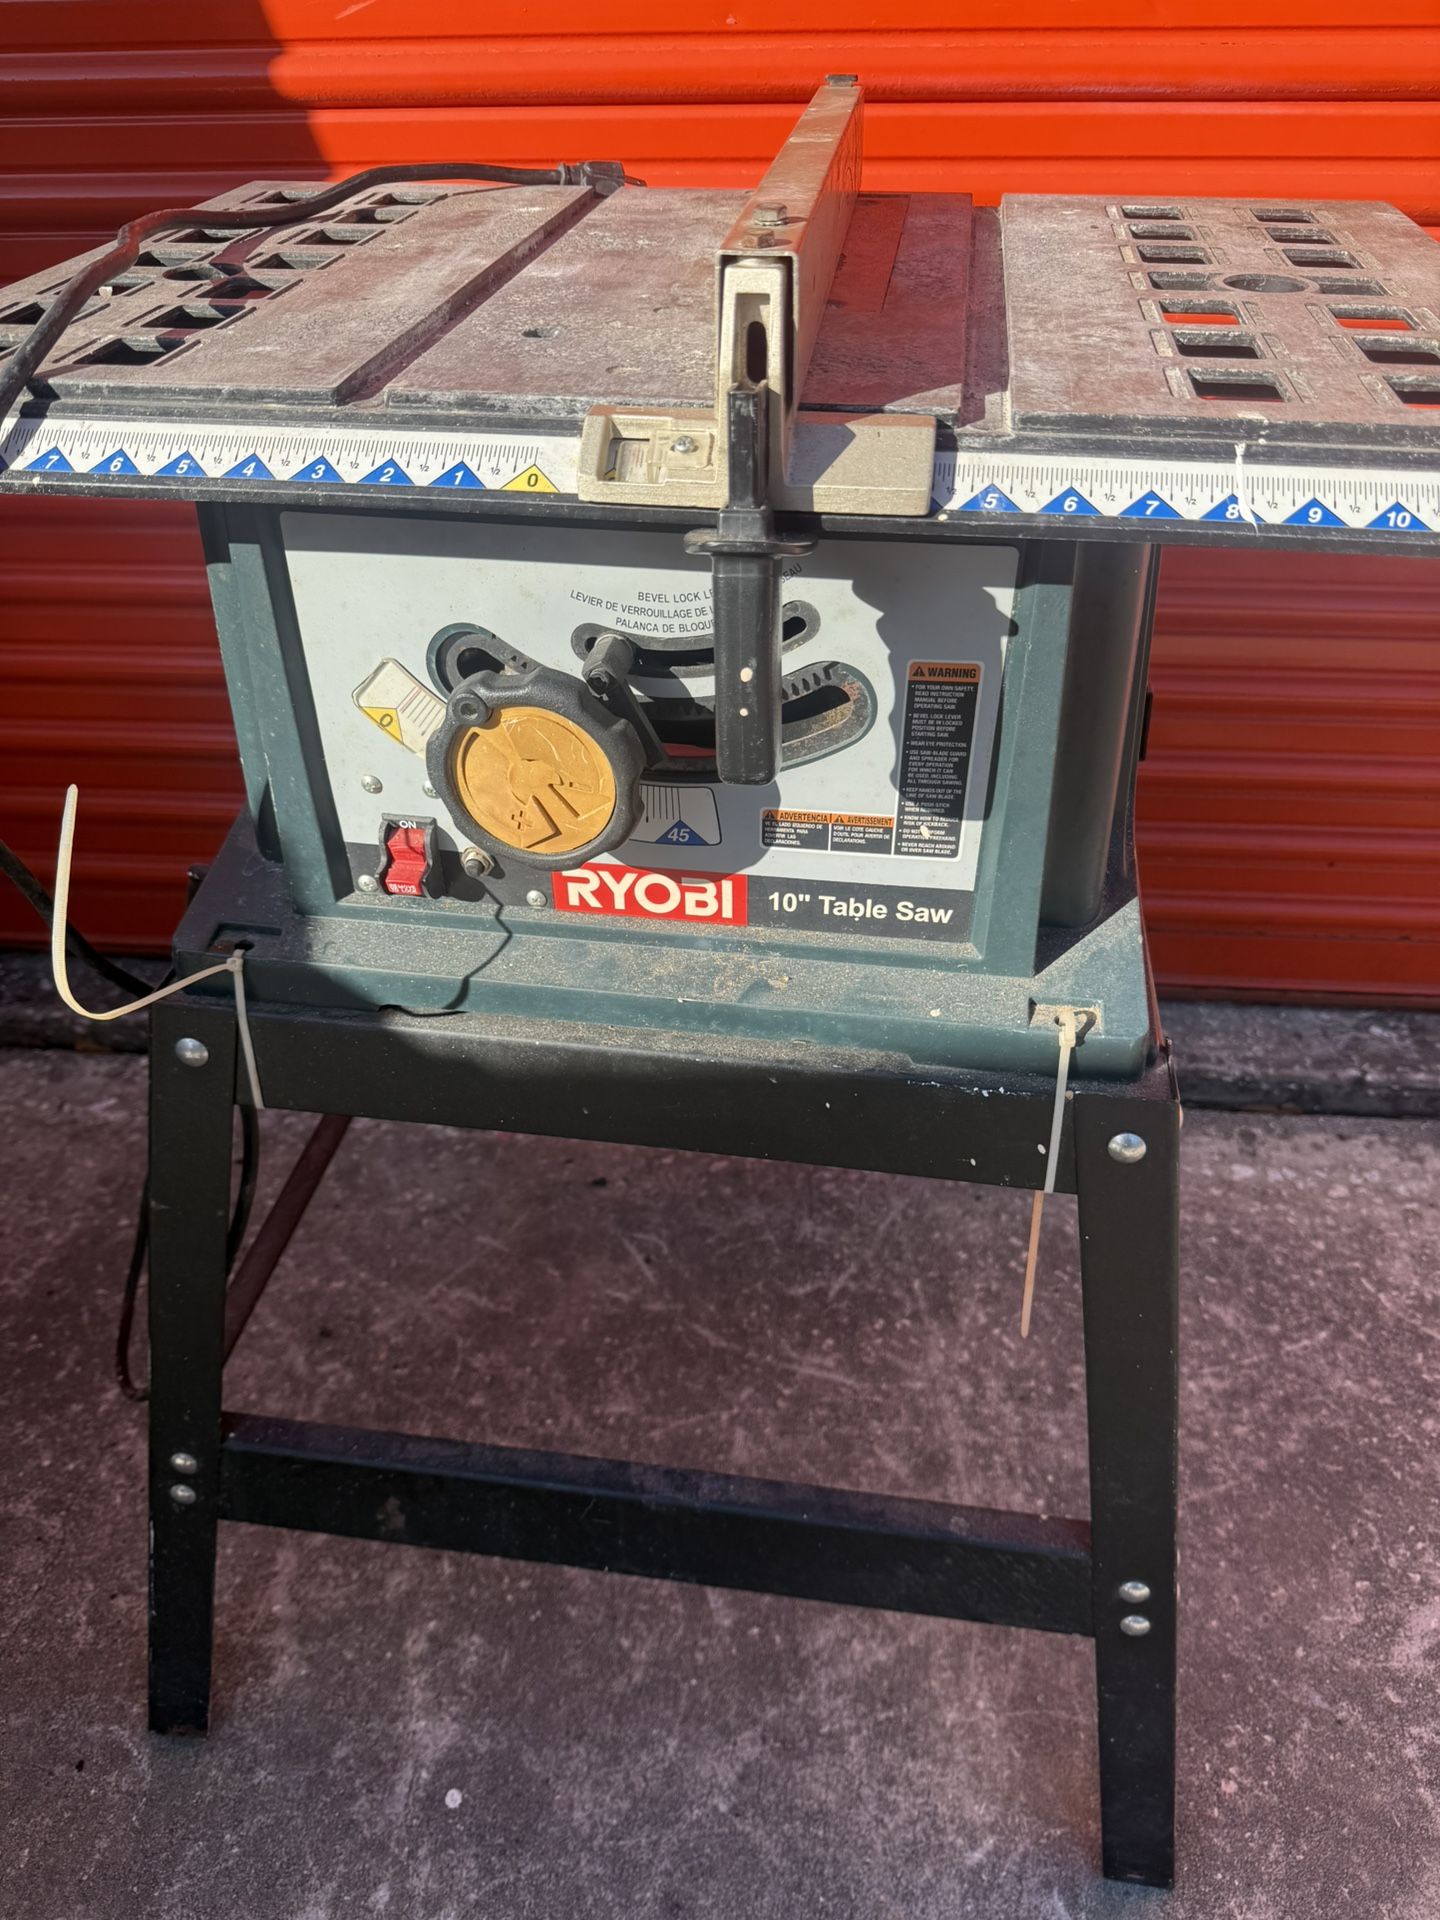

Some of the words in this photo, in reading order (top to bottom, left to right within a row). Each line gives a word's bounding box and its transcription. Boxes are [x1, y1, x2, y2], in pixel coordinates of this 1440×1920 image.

[45, 456, 58, 470] 7
[110, 457, 123, 471] 6
[176, 459, 191, 474] 5
[242, 462, 256, 477] 4
[311, 465, 325, 479] 3
[379, 468, 393, 482] 2
[454, 471, 463, 484] 1
[527, 474, 539, 488] 0
[984, 494, 999, 509] 5
[1063, 496, 1077, 512] 6
[1146, 501, 1159, 516] 7
[1226, 504, 1241, 520] 8
[1308, 508, 1322, 524] 9
[1387, 511, 1410, 527] 10
[570, 590, 604, 608] LEVIER
[606, 601, 618, 612] DE
[621, 604, 692, 619] VERROUILLAGE
[695, 606, 708, 617] DE
[638, 591, 670, 603] BEVEL
[674, 592, 700, 603] LOCK
[616, 617, 659, 632] PALANCA
[662, 622, 676, 633] DE
[928, 667, 976, 678] WARNING
[780, 812, 827, 822] ADVERTENCIA
[847, 817, 892, 826] AVERTISSEMENT
[399, 820, 417, 830] ON
[667, 827, 691, 842] 45
[561, 869, 733, 919] RYOBI
[768, 891, 811, 912] 10"
[818, 895, 888, 922] Table
[895, 902, 952, 924] Saw
